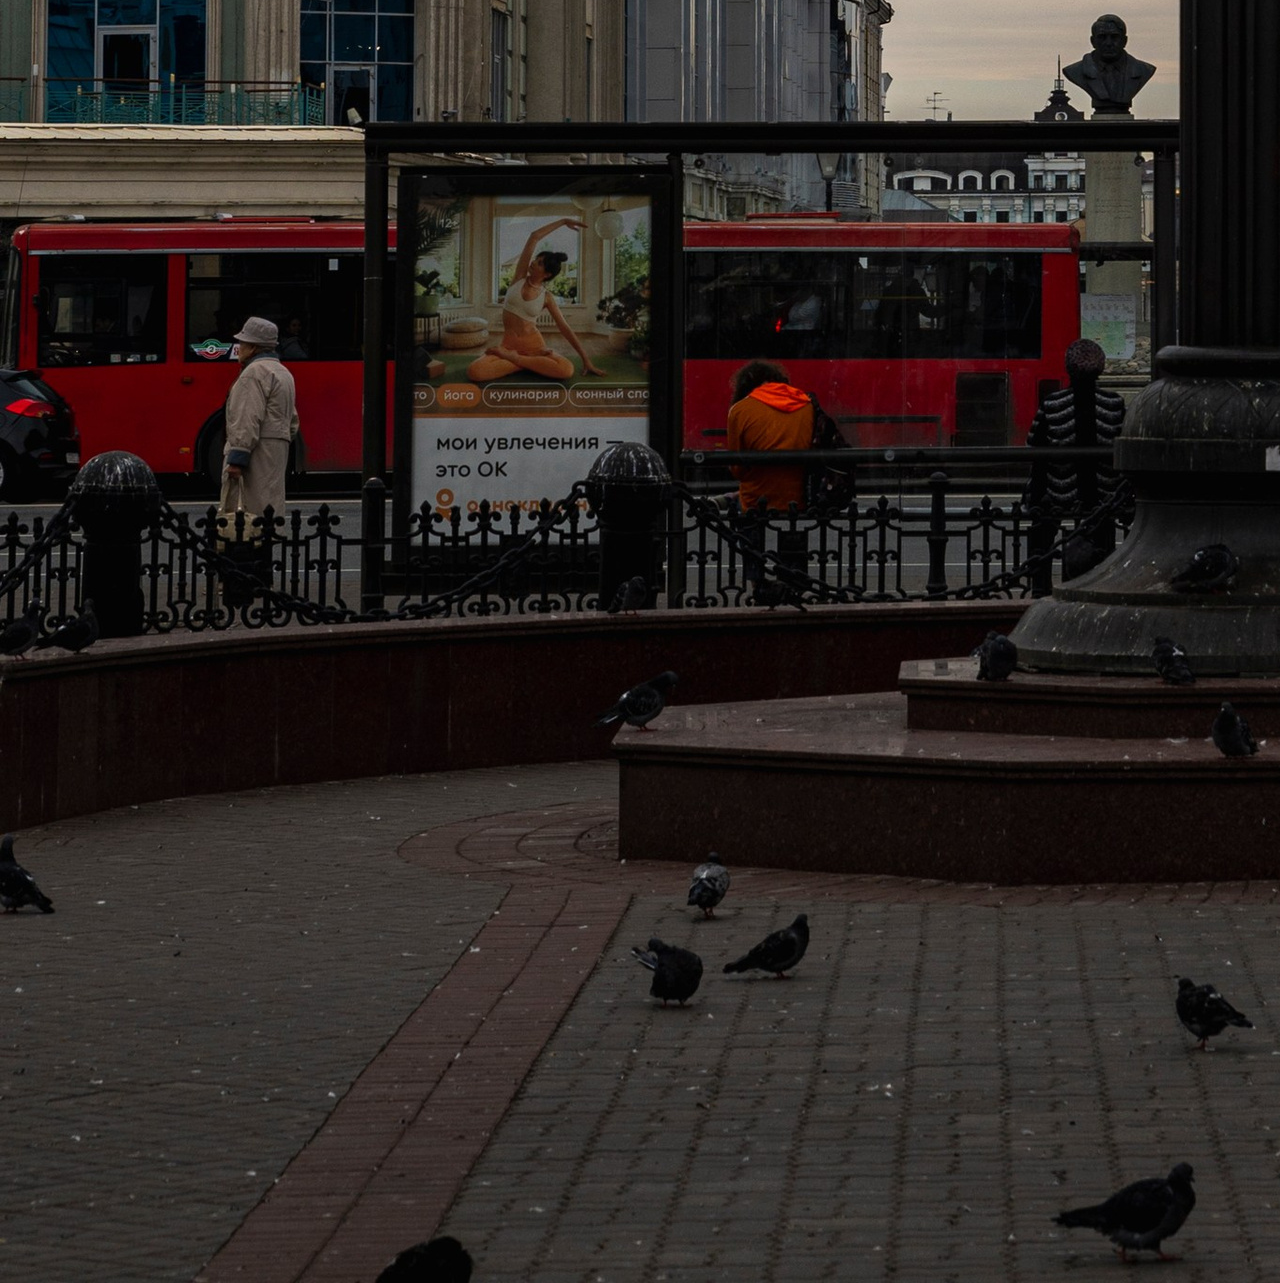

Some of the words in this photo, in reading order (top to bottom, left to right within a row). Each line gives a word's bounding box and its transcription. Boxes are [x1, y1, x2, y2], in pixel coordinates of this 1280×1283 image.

[444, 389, 474, 402] йога
[489, 390, 560, 402] кулинария
[576, 387, 625, 400] конный
[437, 437, 477, 451] мои
[484, 437, 599, 454] увлечения
[436, 463, 471, 478] это
[477, 461, 508, 478] ОК
